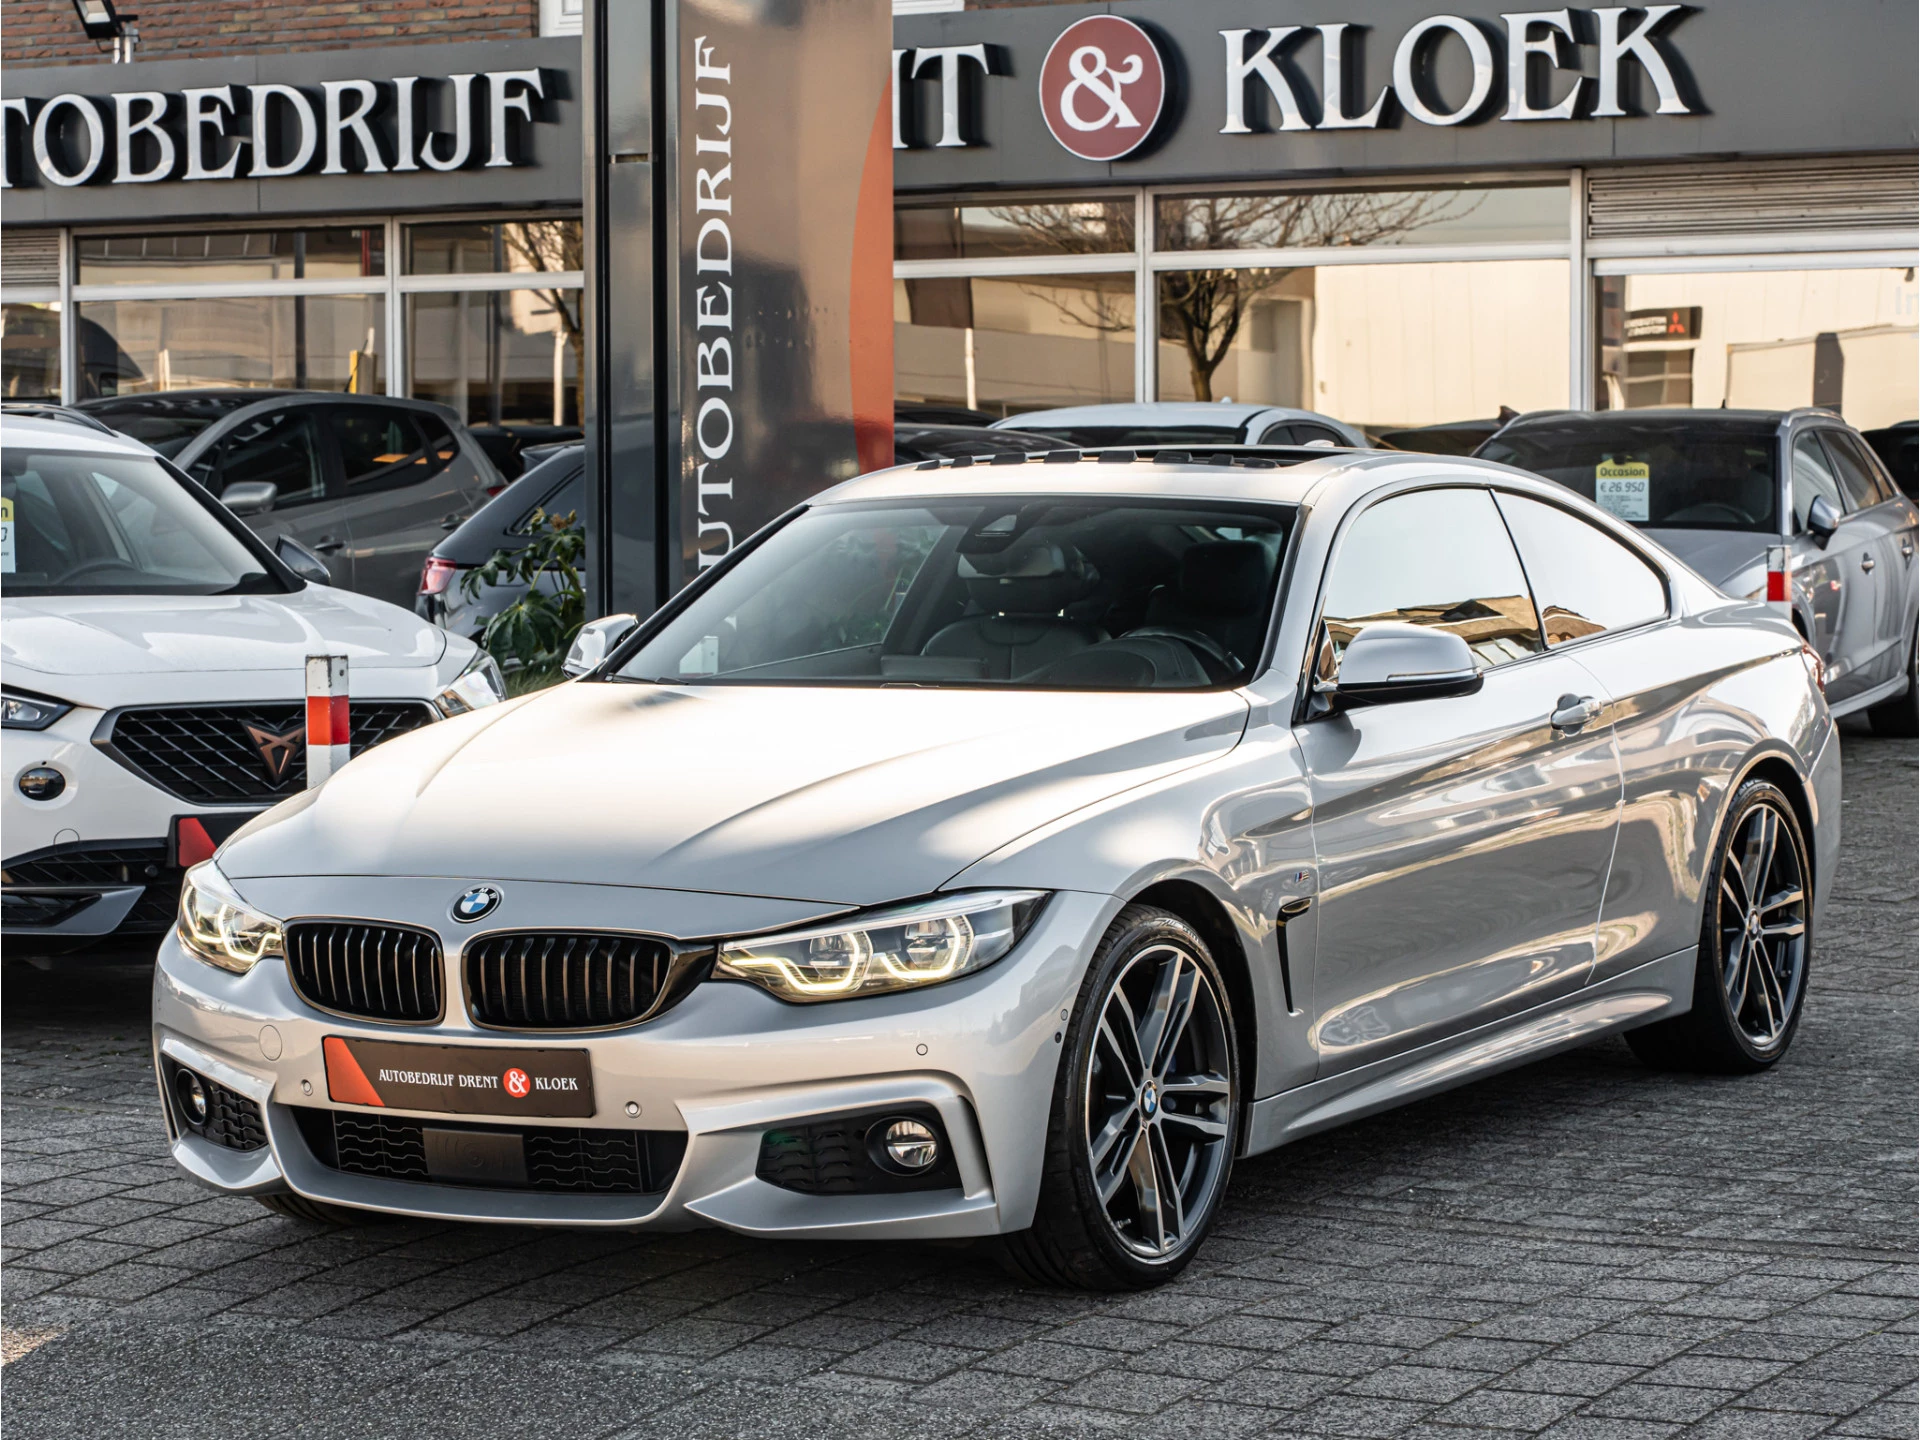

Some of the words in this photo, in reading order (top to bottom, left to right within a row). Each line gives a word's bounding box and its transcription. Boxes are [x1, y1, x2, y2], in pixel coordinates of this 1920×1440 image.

[1060, 45, 1143, 132] &
[1219, 4, 1691, 134] KLOEK
[1599, 466, 1646, 477] Occasion
[1608, 481, 1645, 493] 26.950
[379, 1069, 454, 1087] AUTOBEDRIJF
[459, 1074, 498, 1089] DRENT
[508, 1070, 526, 1094] &
[535, 1077, 579, 1091] KLOEK
